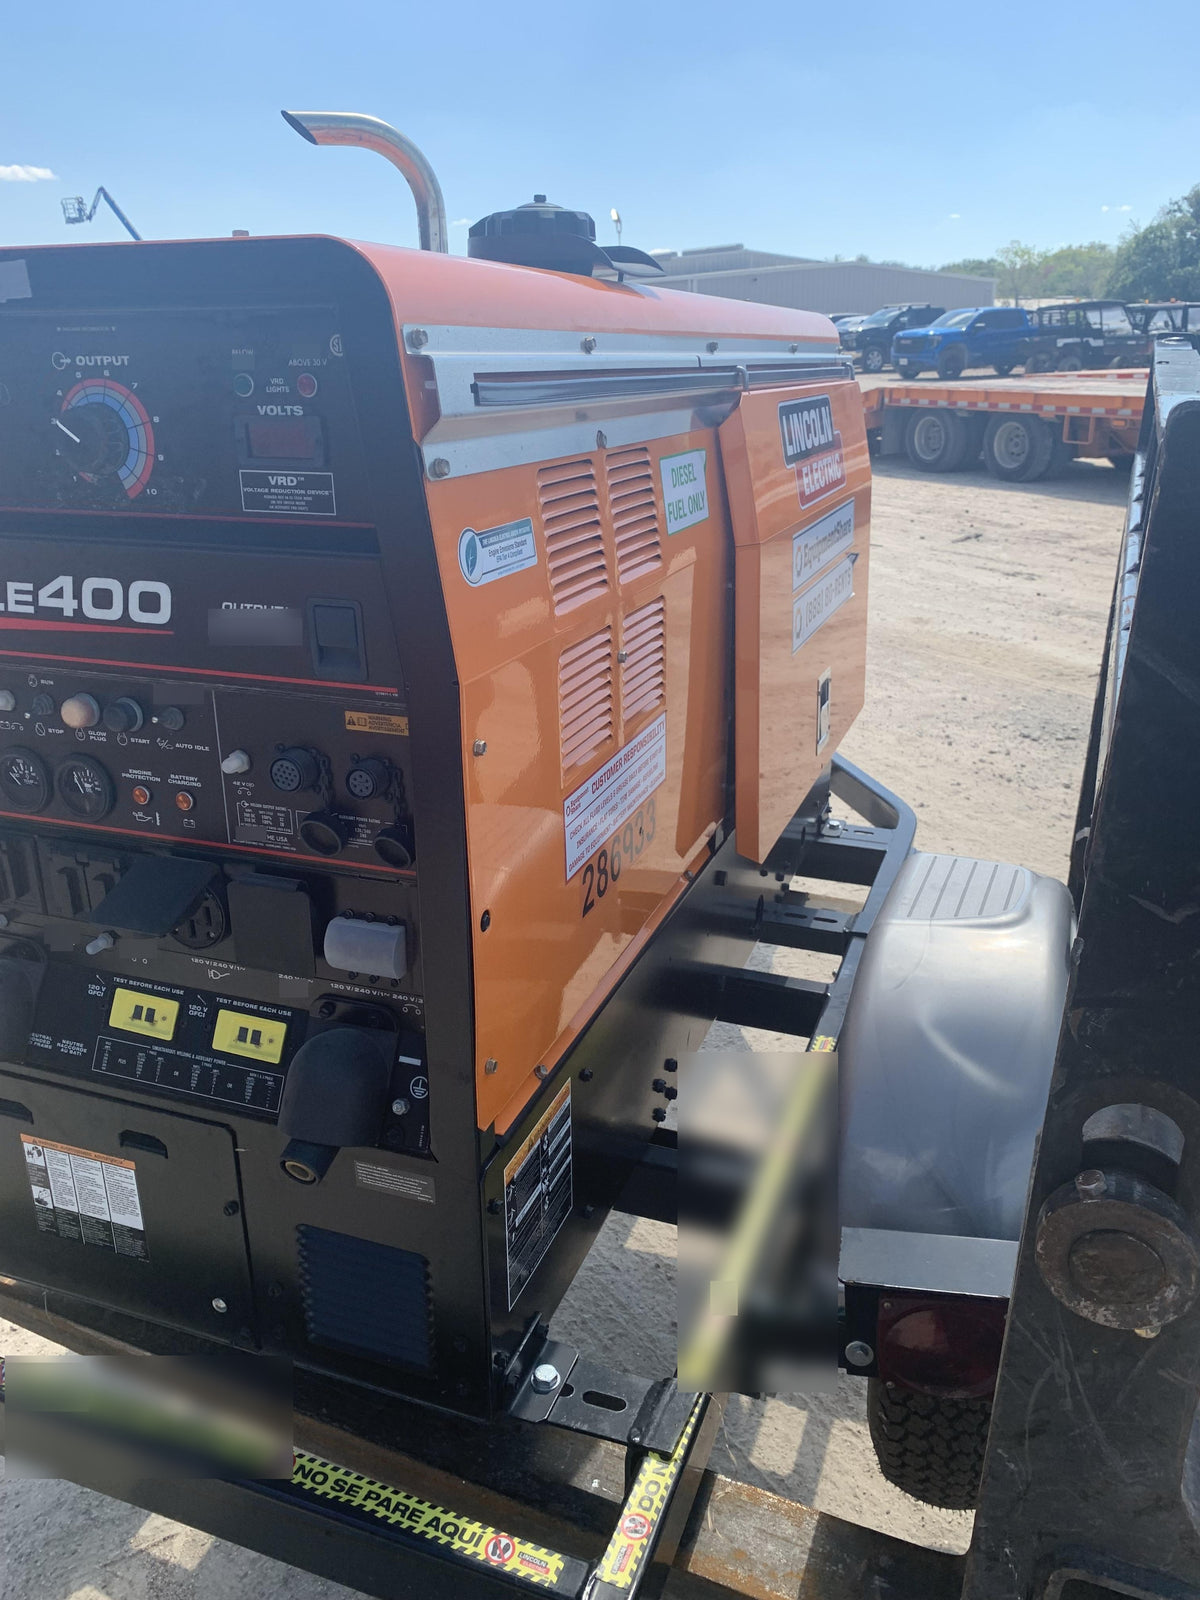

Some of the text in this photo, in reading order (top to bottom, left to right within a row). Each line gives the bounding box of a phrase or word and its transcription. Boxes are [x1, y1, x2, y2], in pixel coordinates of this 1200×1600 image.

[75, 355, 130, 366] OUTPUT
[256, 405, 304, 416] VOLTS
[782, 406, 833, 457] LINCOLN
[157, 454, 165, 462] 9
[671, 463, 697, 488] DIESEL
[801, 453, 841, 497] ELECTRIC
[667, 490, 705, 523] FUEL ONLY
[803, 518, 852, 569] EquipmentShare
[130, 737, 150, 745] START
[175, 742, 193, 750] AUTO
[591, 721, 665, 795] CUSTOMER RESPONSIBILITY
[122, 773, 161, 782] PROTECTION
[129, 768, 152, 776] ENGINE
[170, 774, 198, 782] BATTERY
[168, 779, 202, 787] CHARGING
[570, 787, 589, 808] Equipment
[570, 801, 582, 815] Share
[569, 820, 582, 840] CHECK
[600, 791, 612, 810] LEVELS
[576, 821, 597, 849] INSURANCE
[568, 849, 584, 873] DAMAGE
[582, 798, 657, 918] 286933
[191, 957, 204, 965] 120
[205, 960, 228, 968] V/240
[87, 989, 104, 997] GFCI
[88, 983, 100, 992] 120
[113, 976, 185, 996] TEST BEFORE EACH USE
[345, 985, 370, 994] V/240
[392, 993, 408, 1001] 240
[188, 1004, 202, 1012] 120
[188, 1009, 206, 1018] GFCI
[232, 1000, 256, 1010] BEFORE
[258, 1005, 277, 1014] EACH
[278, 1009, 292, 1017] USE
[30, 1037, 51, 1045] ONDED
[31, 1032, 53, 1041] EUTRAL
[62, 1039, 84, 1048] NEUTRE
[638, 1480, 661, 1512] DO
[293, 1463, 486, 1548] NO SE PARE AQUÍ
[519, 1552, 547, 1568] LINCOLN
